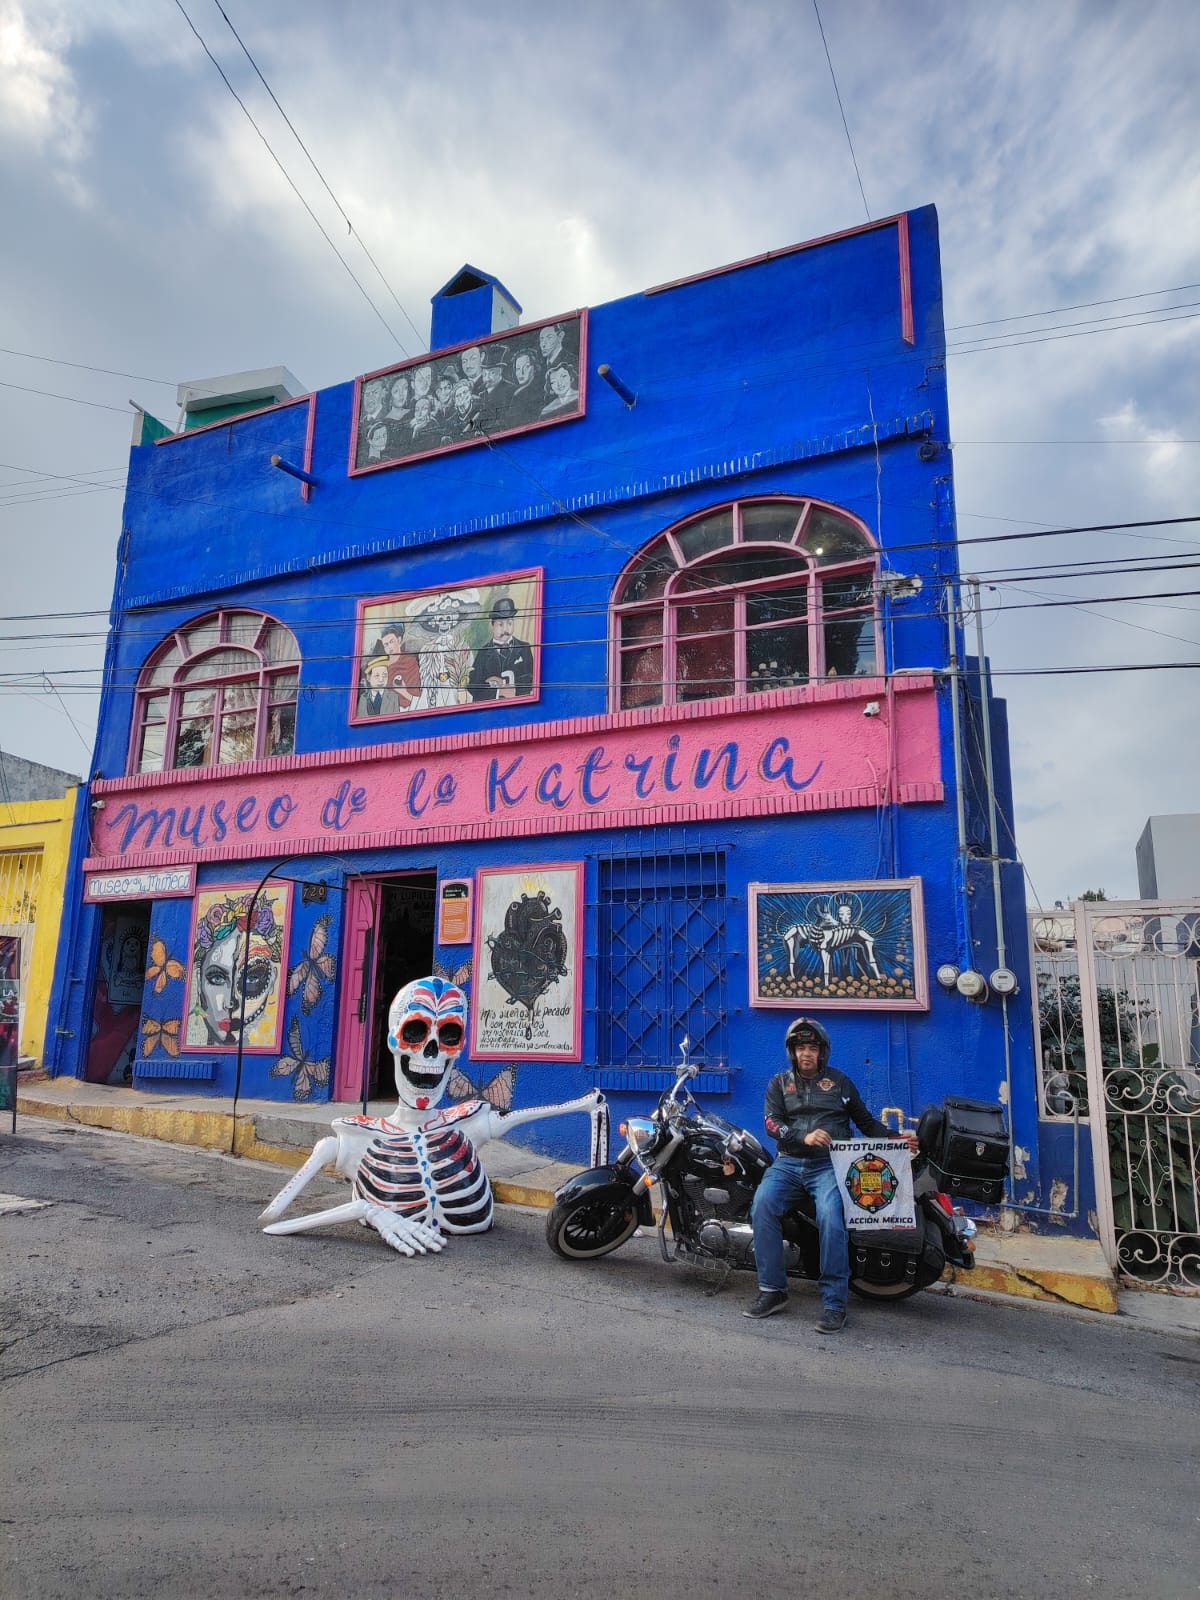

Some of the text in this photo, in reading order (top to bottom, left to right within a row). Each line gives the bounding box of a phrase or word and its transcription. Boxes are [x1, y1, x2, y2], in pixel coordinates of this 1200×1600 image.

[321, 780, 368, 831] de
[406, 768, 457, 818] la
[487, 734, 823, 813] Katrina
[848, 1215, 913, 1225] ACCIÓN MÉXICO
